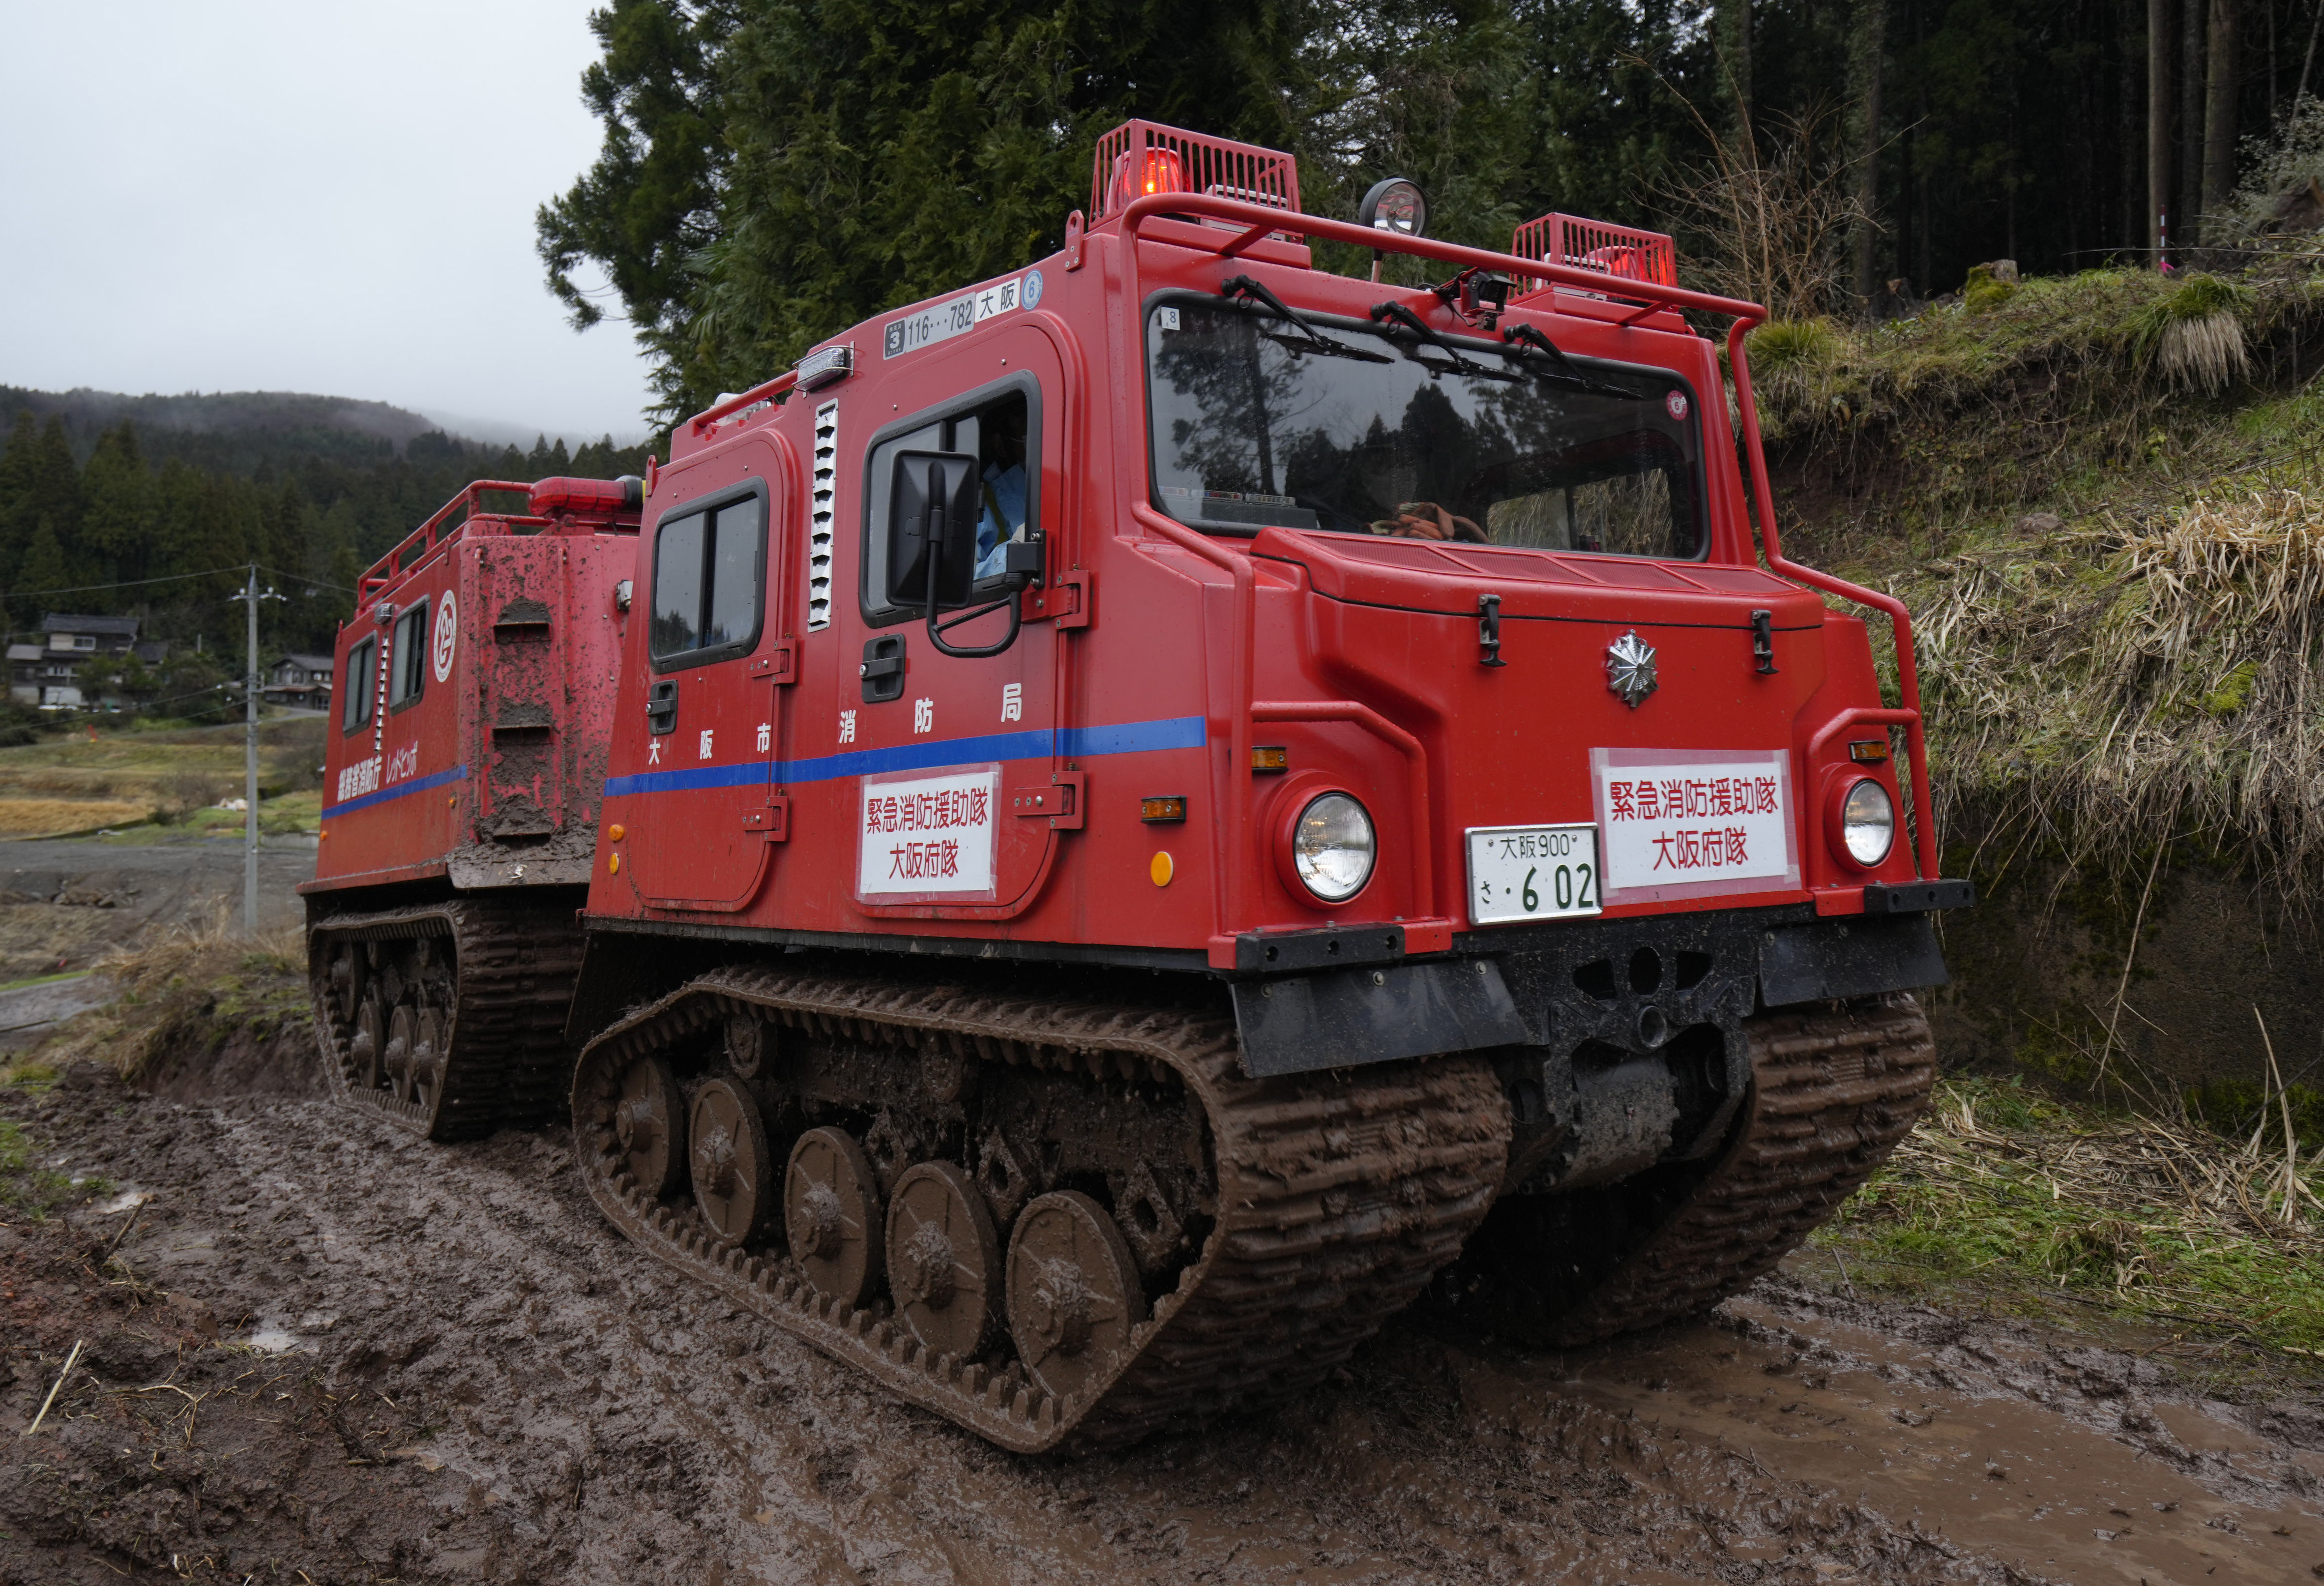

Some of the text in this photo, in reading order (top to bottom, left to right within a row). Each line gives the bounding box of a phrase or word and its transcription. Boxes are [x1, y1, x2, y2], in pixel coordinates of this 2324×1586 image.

[979, 282, 1015, 319] 大阪
[889, 331, 900, 350] 3
[1675, 402, 1679, 411] 6
[337, 740, 418, 803] 総務省消防庁 レッドヒッポ
[867, 785, 988, 834] 緊急消防援助隊
[1610, 775, 1778, 822] 緊急消防援助隊
[889, 838, 958, 879] 大阪府隊
[1652, 825, 1748, 871] 大阪府隊
[1480, 881, 1490, 904] さ
